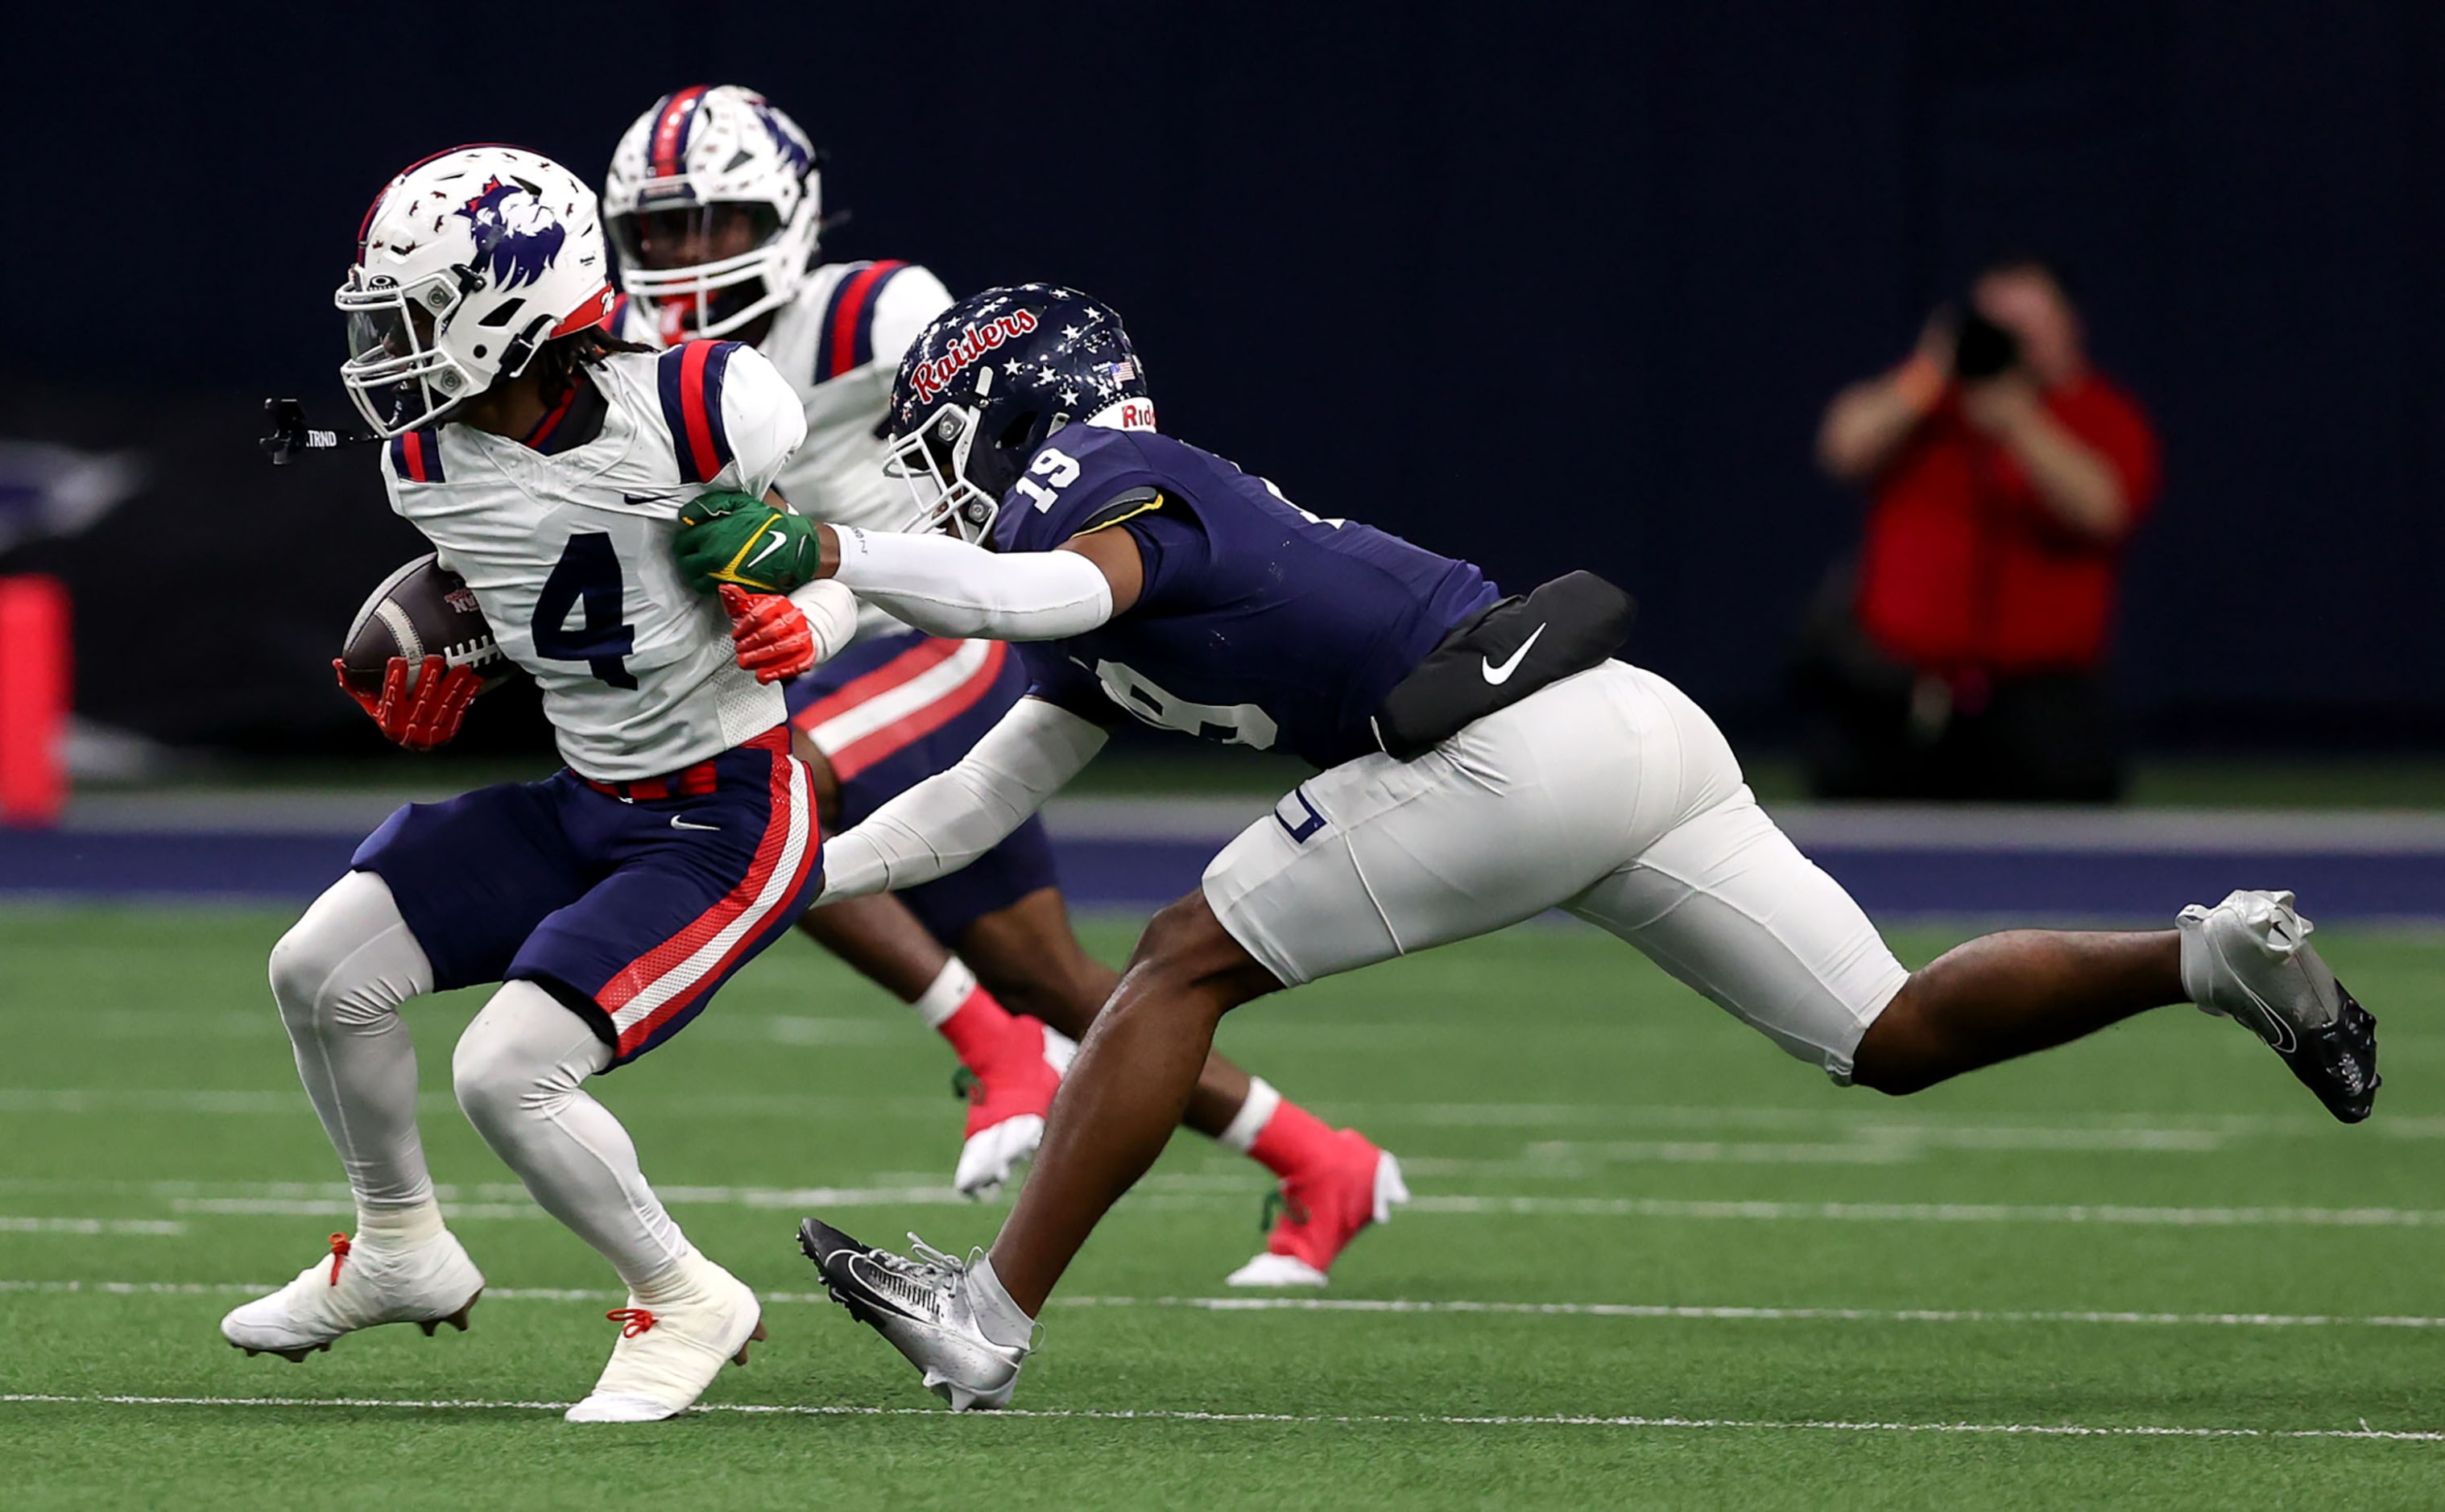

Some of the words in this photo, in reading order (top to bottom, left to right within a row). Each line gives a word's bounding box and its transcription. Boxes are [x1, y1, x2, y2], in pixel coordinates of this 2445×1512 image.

[909, 308, 1038, 404] Raiders
[1016, 447, 1080, 514] 19
[531, 531, 639, 691] 4
